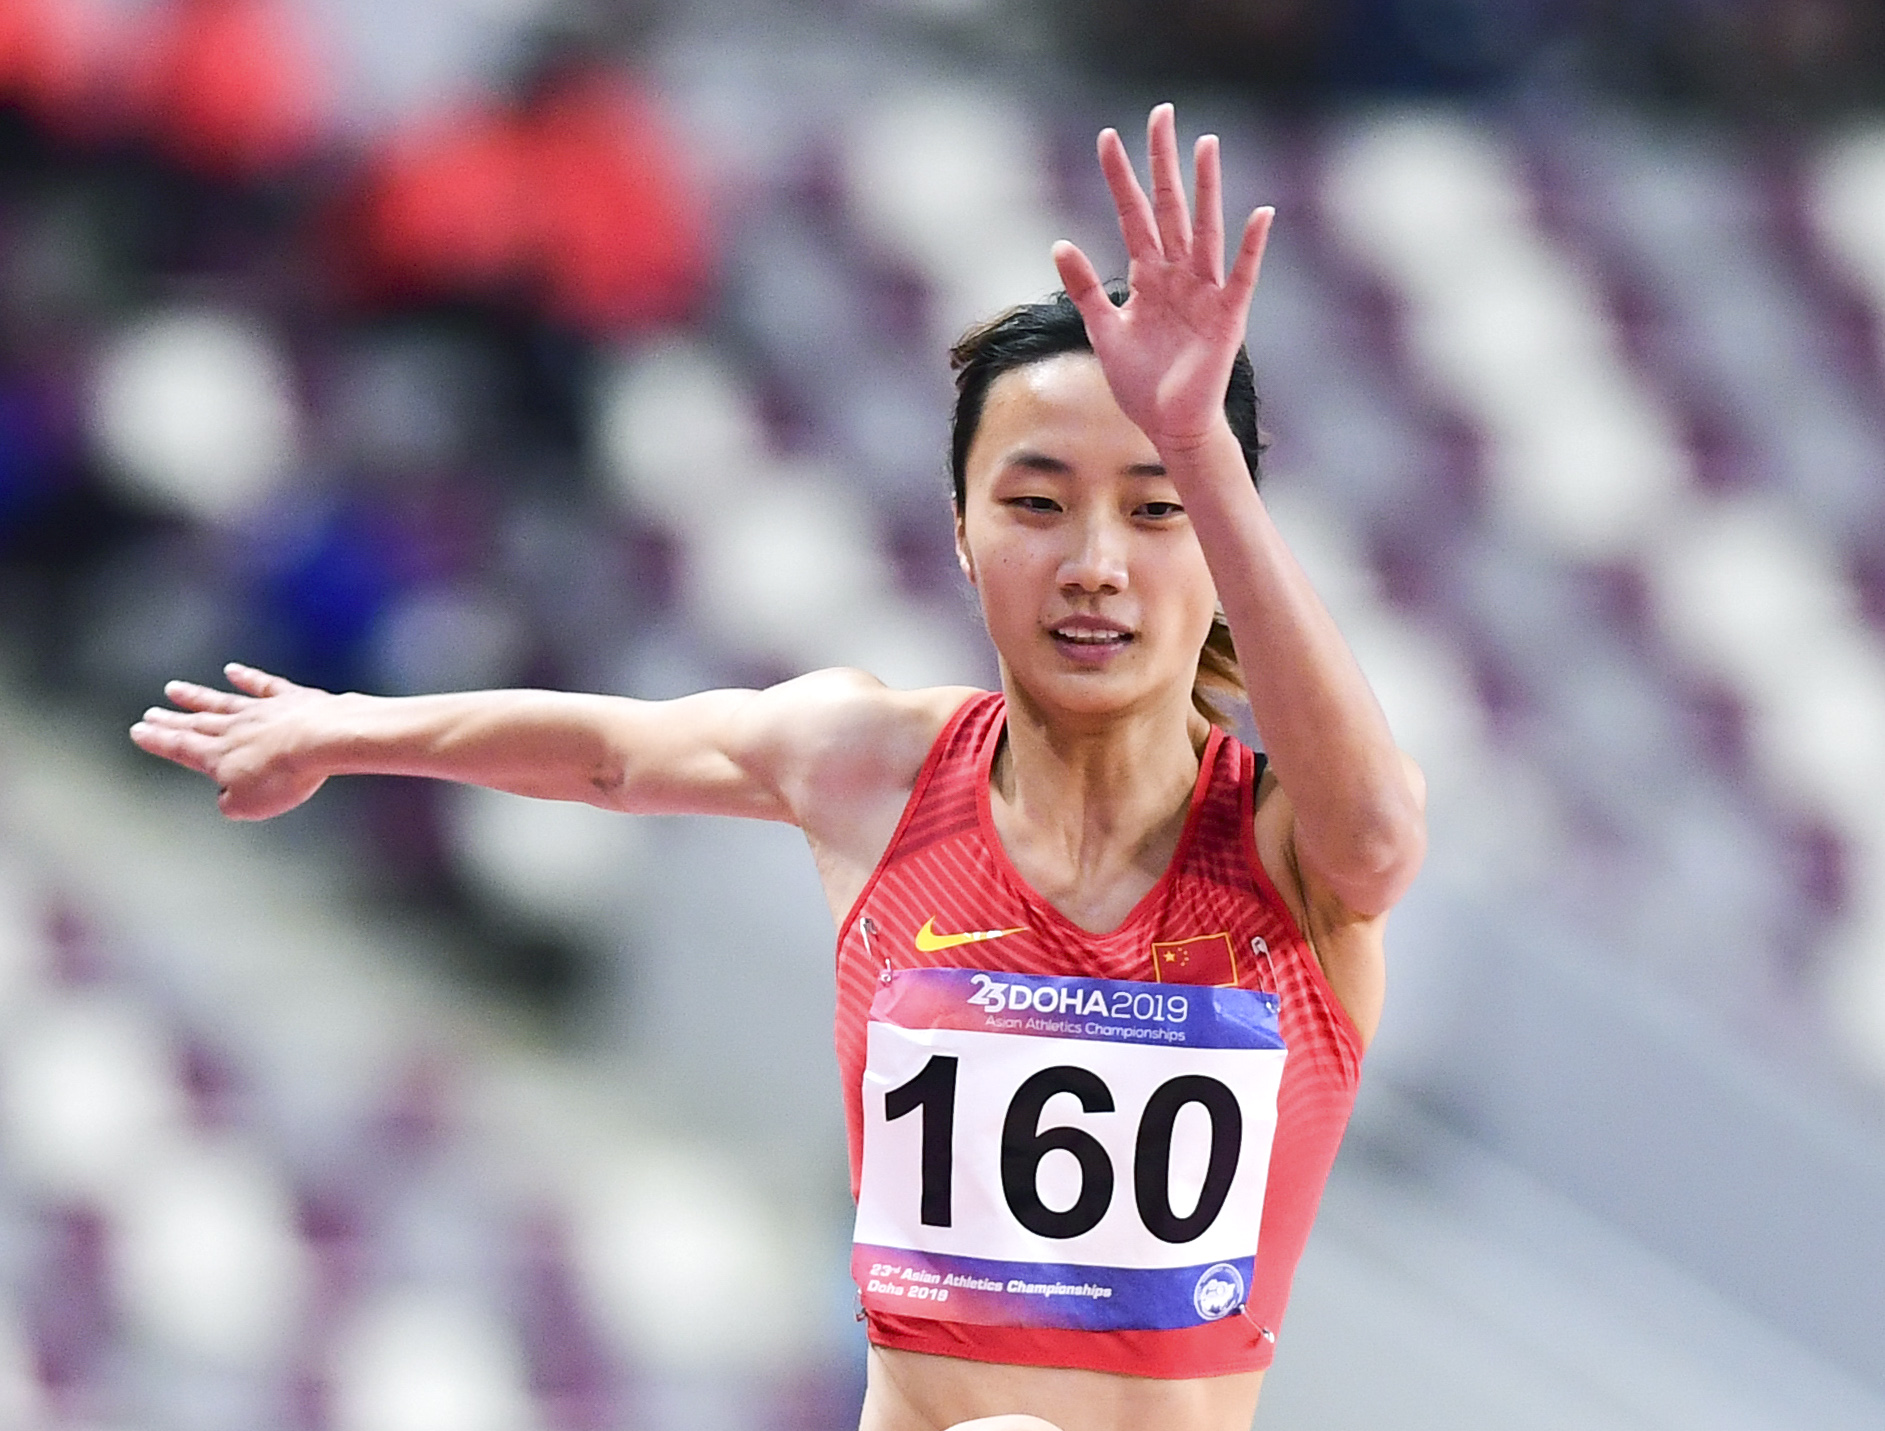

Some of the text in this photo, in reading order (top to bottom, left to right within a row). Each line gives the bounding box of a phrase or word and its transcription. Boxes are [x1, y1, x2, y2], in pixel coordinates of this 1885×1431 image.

[985, 1014, 1186, 1042] Asian Athletics Championships
[885, 1054, 1243, 1244] 160
[867, 1279, 949, 1302] Doha 2019
[901, 1267, 941, 1285] Asian
[943, 1273, 1004, 1293] Athletics
[1006, 1279, 1113, 1300] Championships
